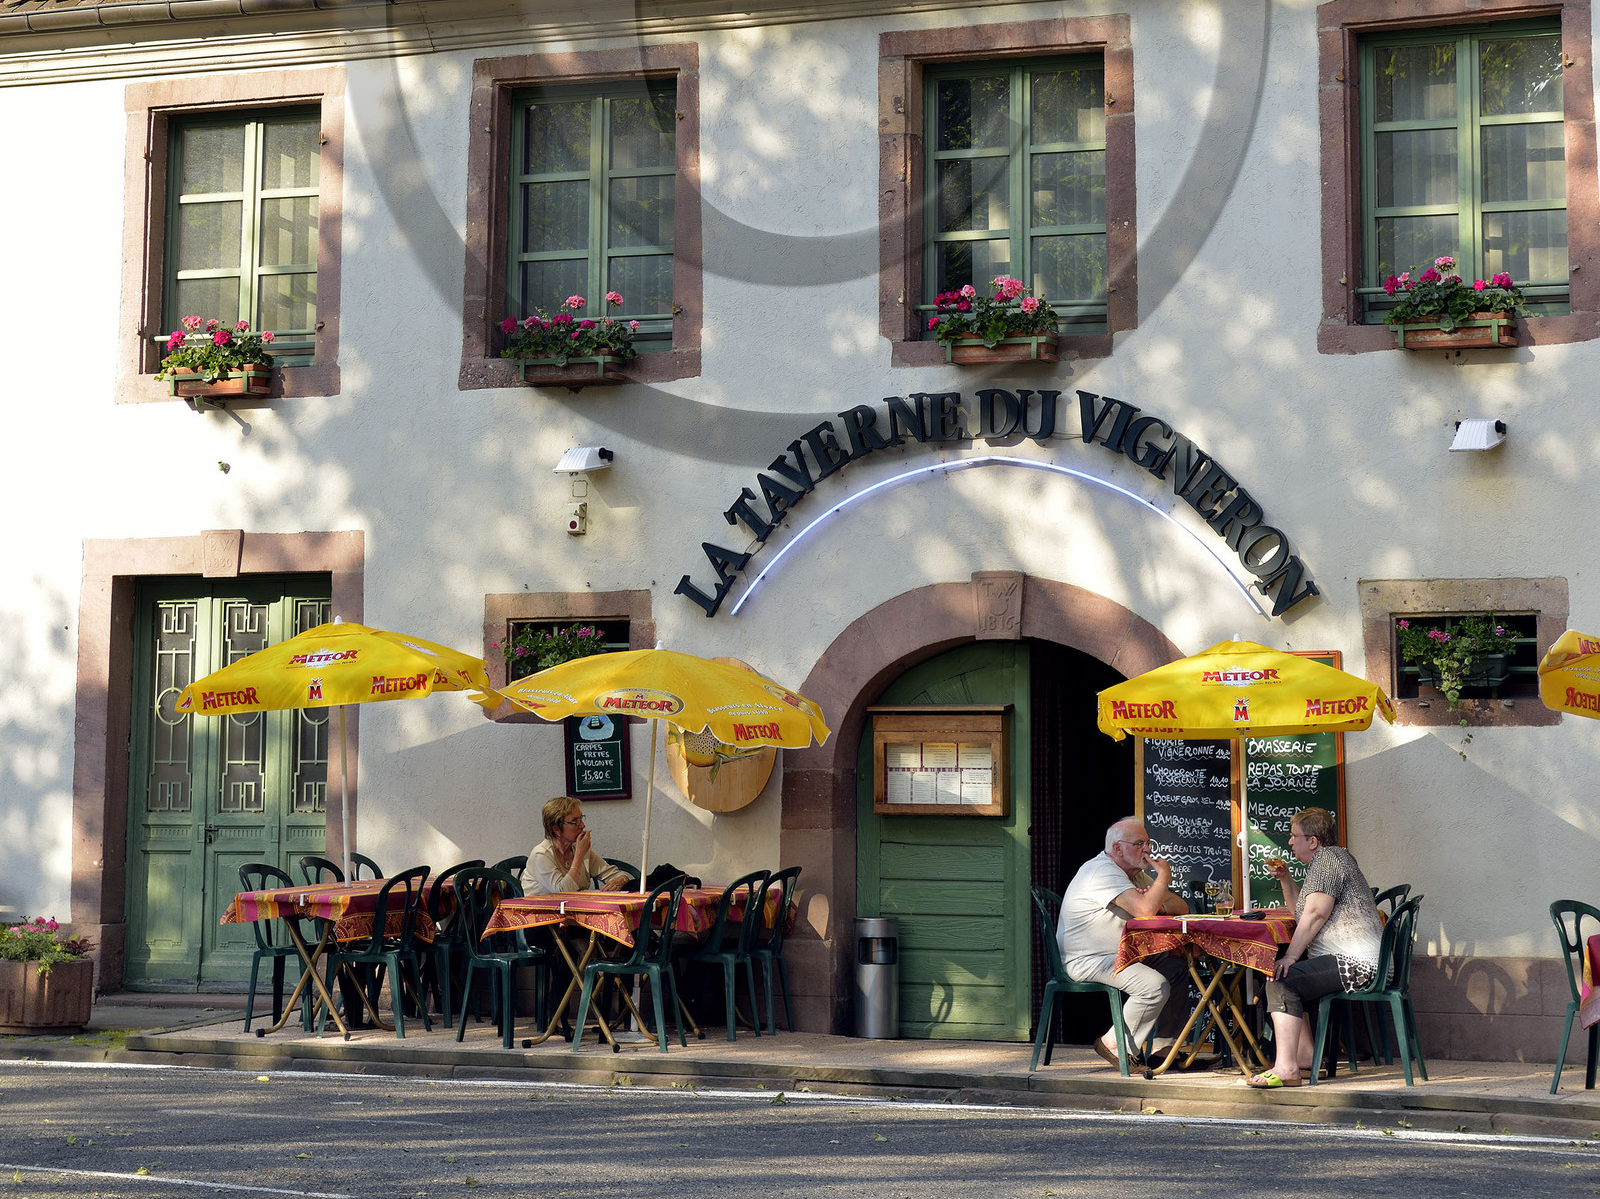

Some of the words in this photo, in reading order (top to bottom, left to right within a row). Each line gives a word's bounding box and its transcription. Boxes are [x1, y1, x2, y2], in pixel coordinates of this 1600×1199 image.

[674, 542, 752, 618] LA
[723, 391, 963, 543] TAVERNE
[975, 388, 1061, 440] DU
[1076, 390, 1320, 617] VIGNERON
[289, 650, 358, 665] METEOR
[371, 673, 427, 695] METEOR
[1201, 669, 1280, 682] METEOR
[202, 687, 260, 710] METEOR
[602, 696, 673, 712] METEOR
[1305, 696, 1368, 718] METEOR
[1111, 700, 1177, 720] METEOR
[732, 722, 783, 741] METEOR
[1247, 737, 1318, 755] BRASSERIE
[1248, 762, 1284, 776] REPAS
[1285, 764, 1323, 775] TOUTE
[1245, 778, 1261, 788] LA
[1249, 817, 1269, 831] DE
